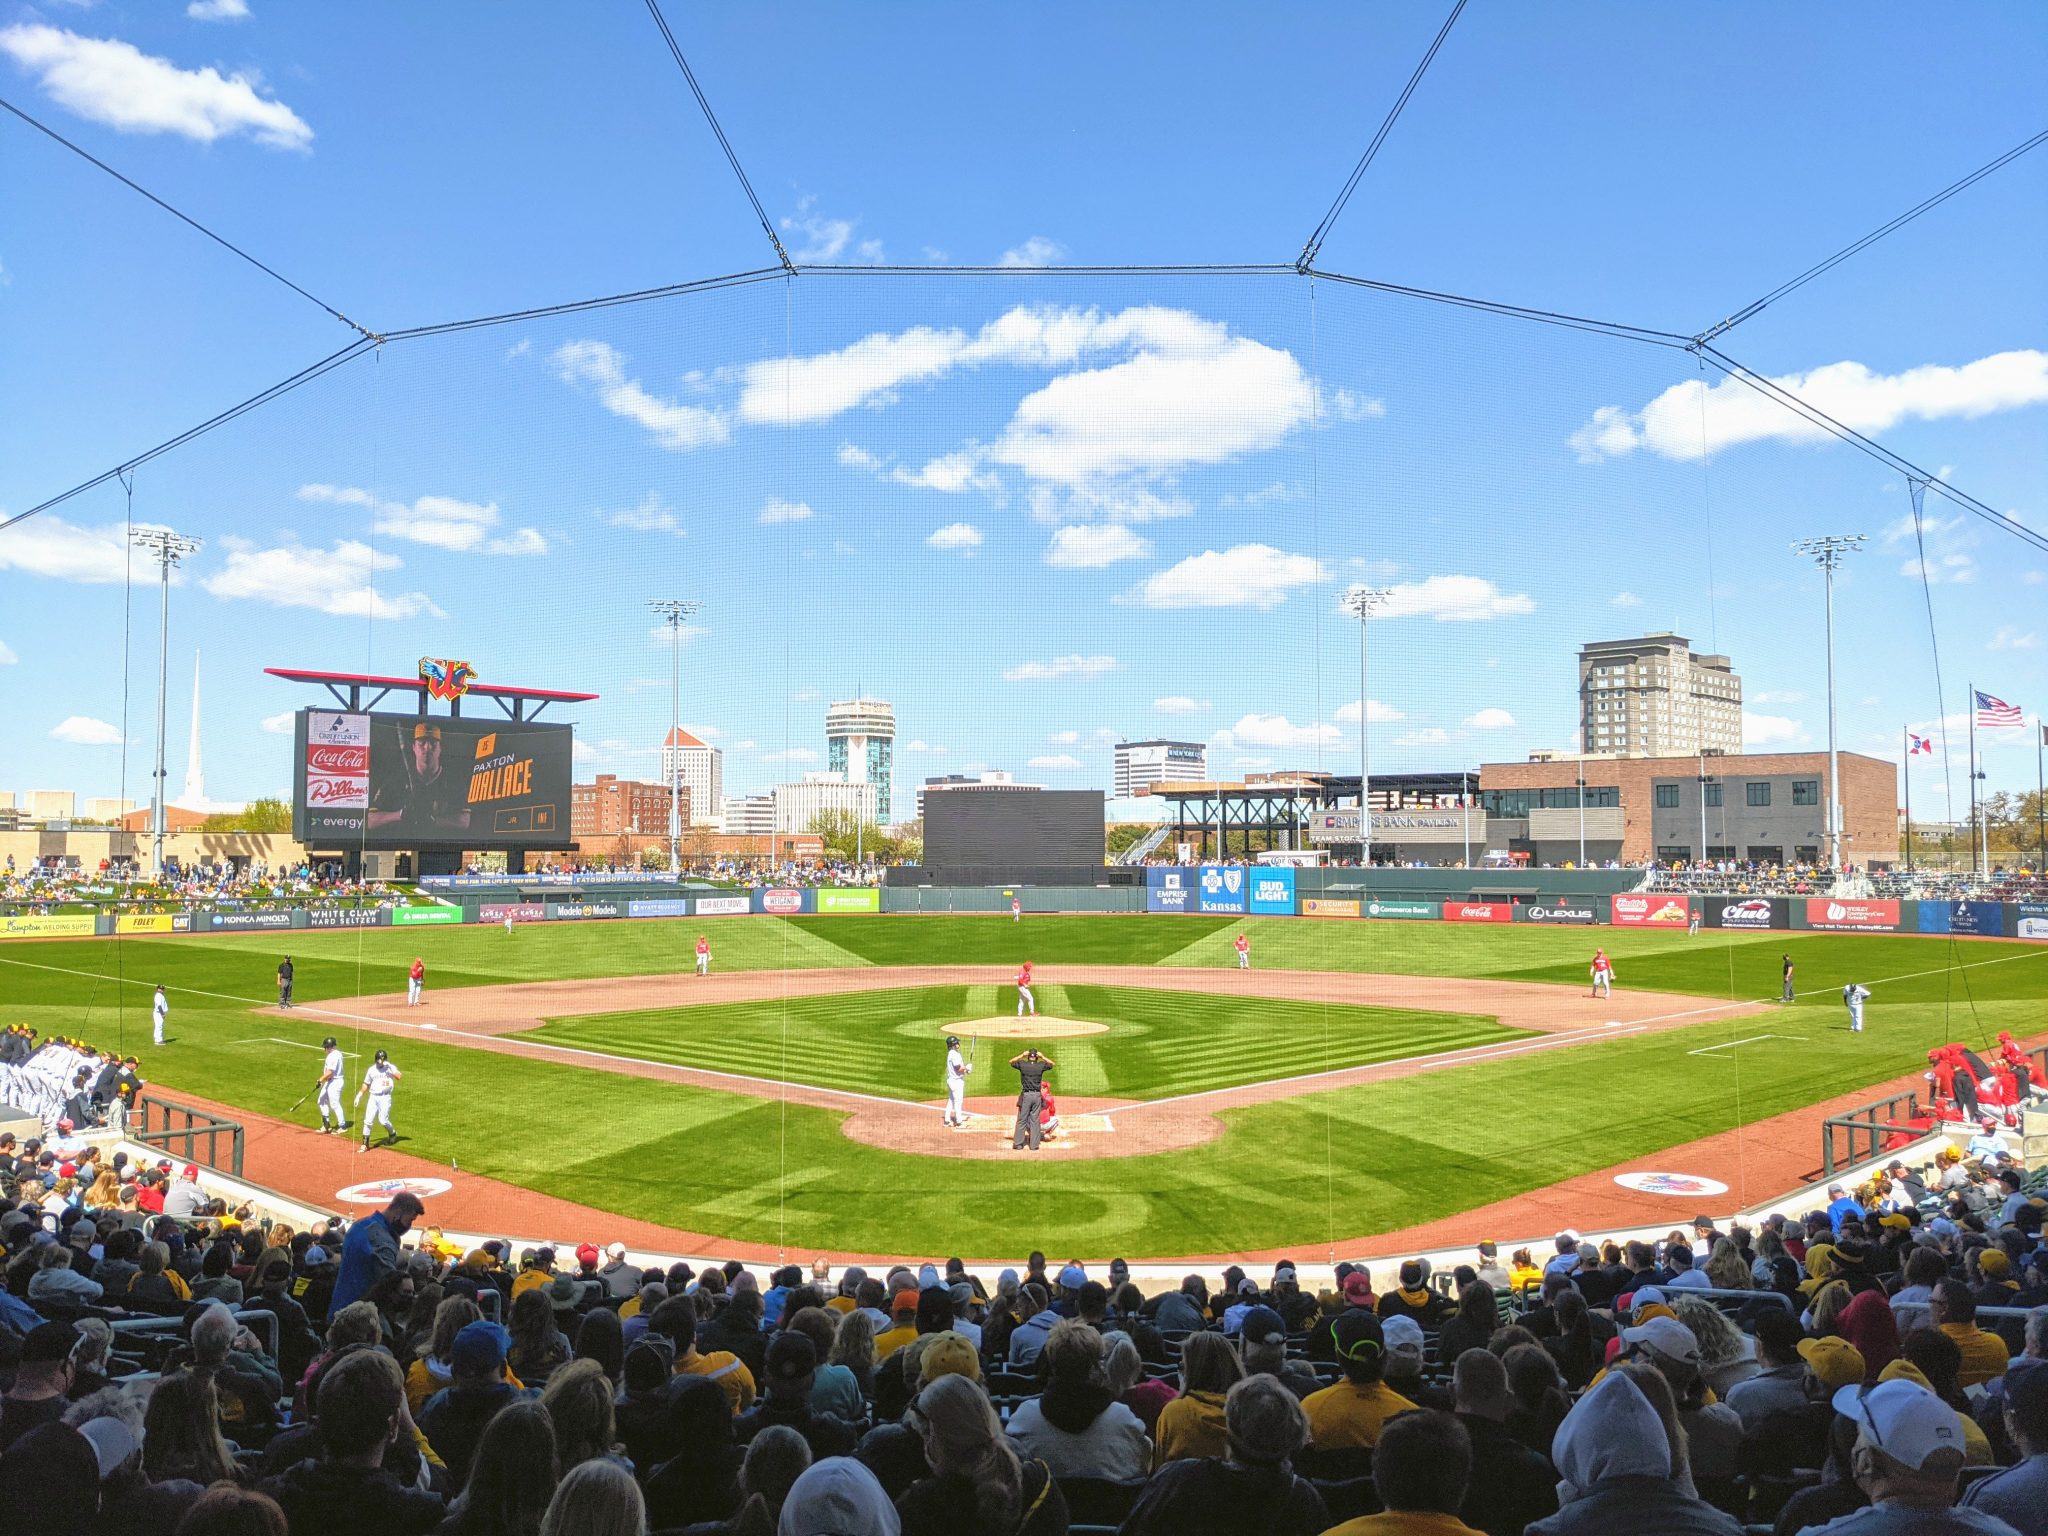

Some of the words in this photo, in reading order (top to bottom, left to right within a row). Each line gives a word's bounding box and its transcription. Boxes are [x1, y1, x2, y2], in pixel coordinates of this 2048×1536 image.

[473, 753, 515, 773] PAXTON
[467, 759, 533, 803] WALLACE
[323, 818, 363, 829] evergy
[1384, 816, 1415, 828] BANK
[1259, 881, 1284, 891] BUD
[1255, 891, 1289, 901] LIGHT
[557, 905, 582, 916] Modelo
[592, 904, 617, 914] Modelo
[1202, 901, 1243, 912] Kansas
[311, 910, 345, 918] WHITE
[350, 909, 377, 917] CLAW
[1545, 910, 1593, 918] LEXUS
[1722, 905, 1771, 920] Club
[133, 917, 156, 926] FOLEY
[173, 918, 189, 928] CAT
[224, 915, 255, 924] KONICA
[256, 914, 290, 923] MINOLTA
